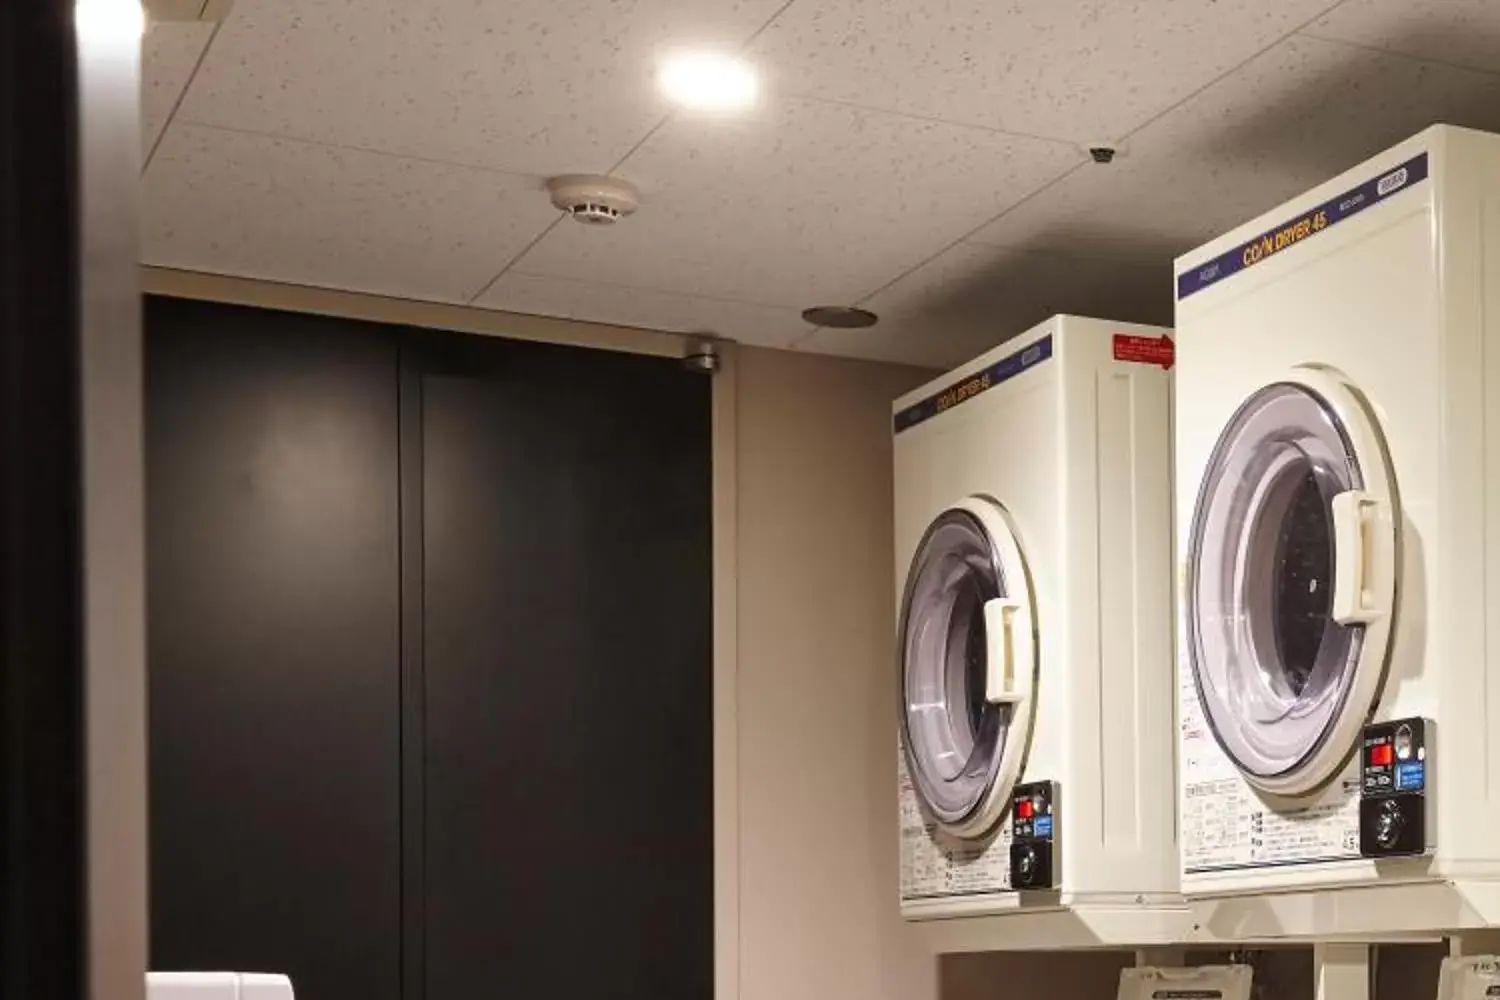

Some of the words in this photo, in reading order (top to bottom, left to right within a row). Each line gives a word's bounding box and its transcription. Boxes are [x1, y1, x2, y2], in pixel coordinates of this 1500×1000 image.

[1243, 236, 1274, 266] COIN
[1275, 218, 1311, 250] DRYER
[1311, 210, 1328, 231] 45
